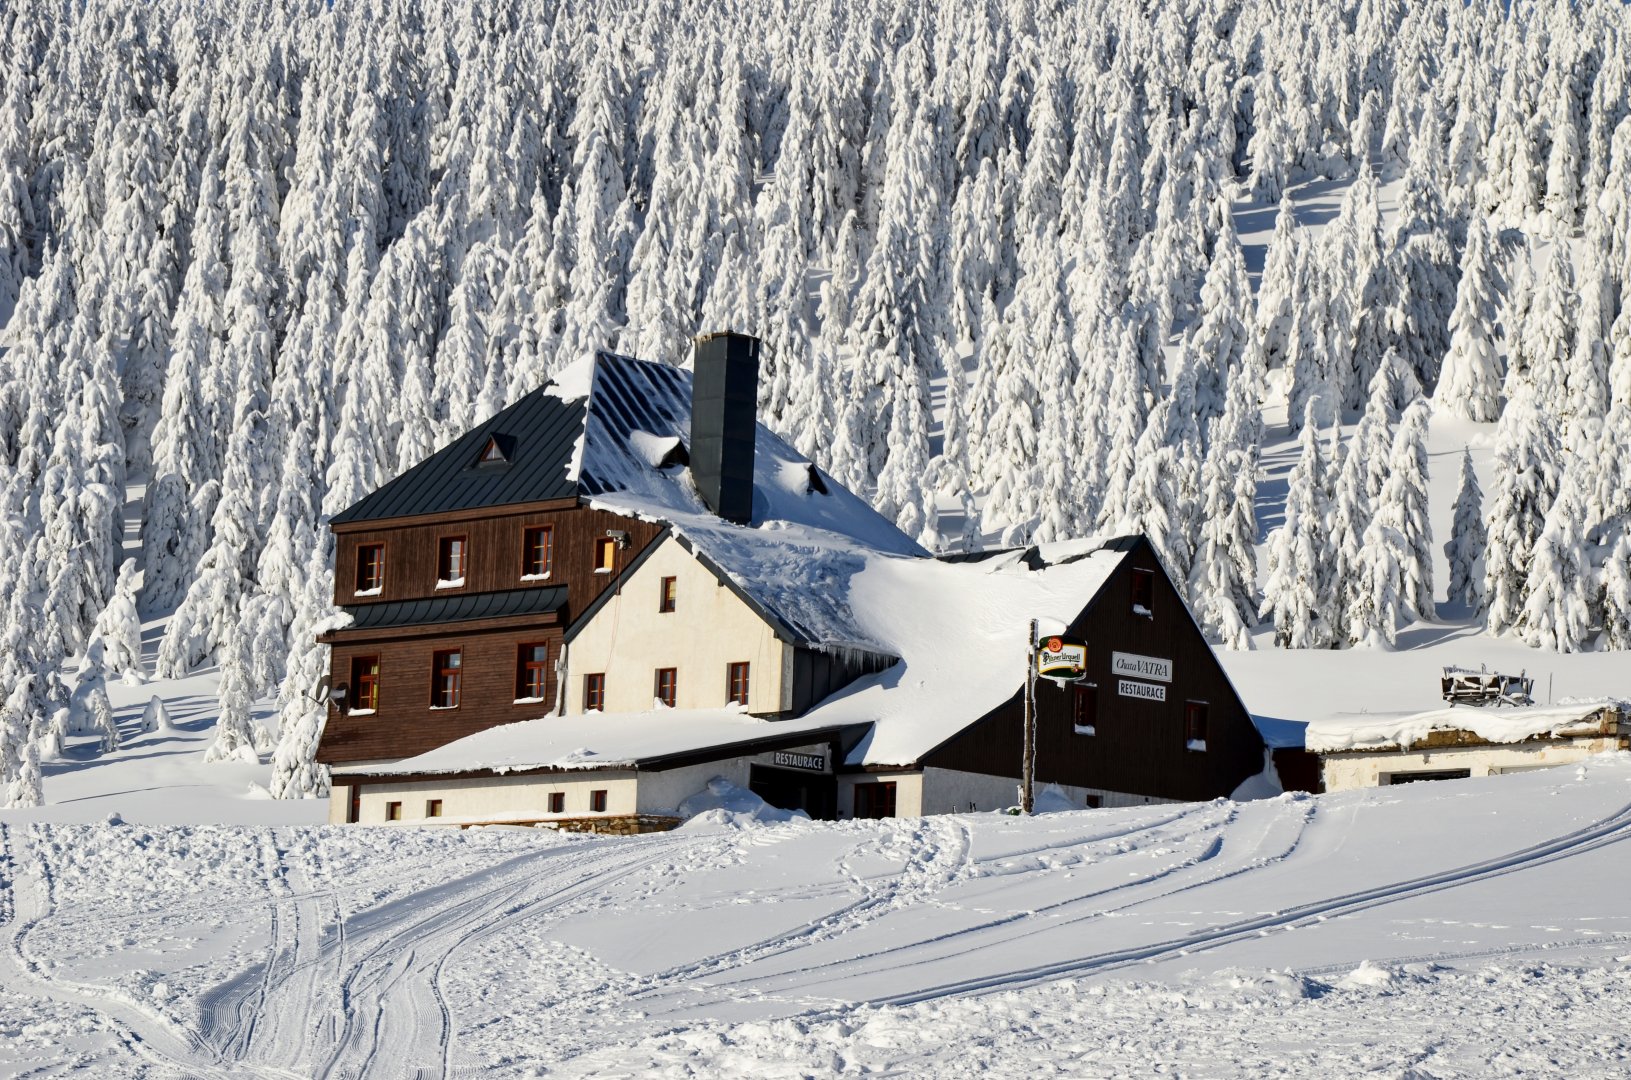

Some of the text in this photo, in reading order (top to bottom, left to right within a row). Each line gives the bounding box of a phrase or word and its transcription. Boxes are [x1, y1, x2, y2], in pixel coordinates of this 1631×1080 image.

[1116, 658, 1168, 677] Chata VATRA
[1120, 682, 1164, 699] RESTAURACE
[775, 752, 823, 769] RESTAURACE
